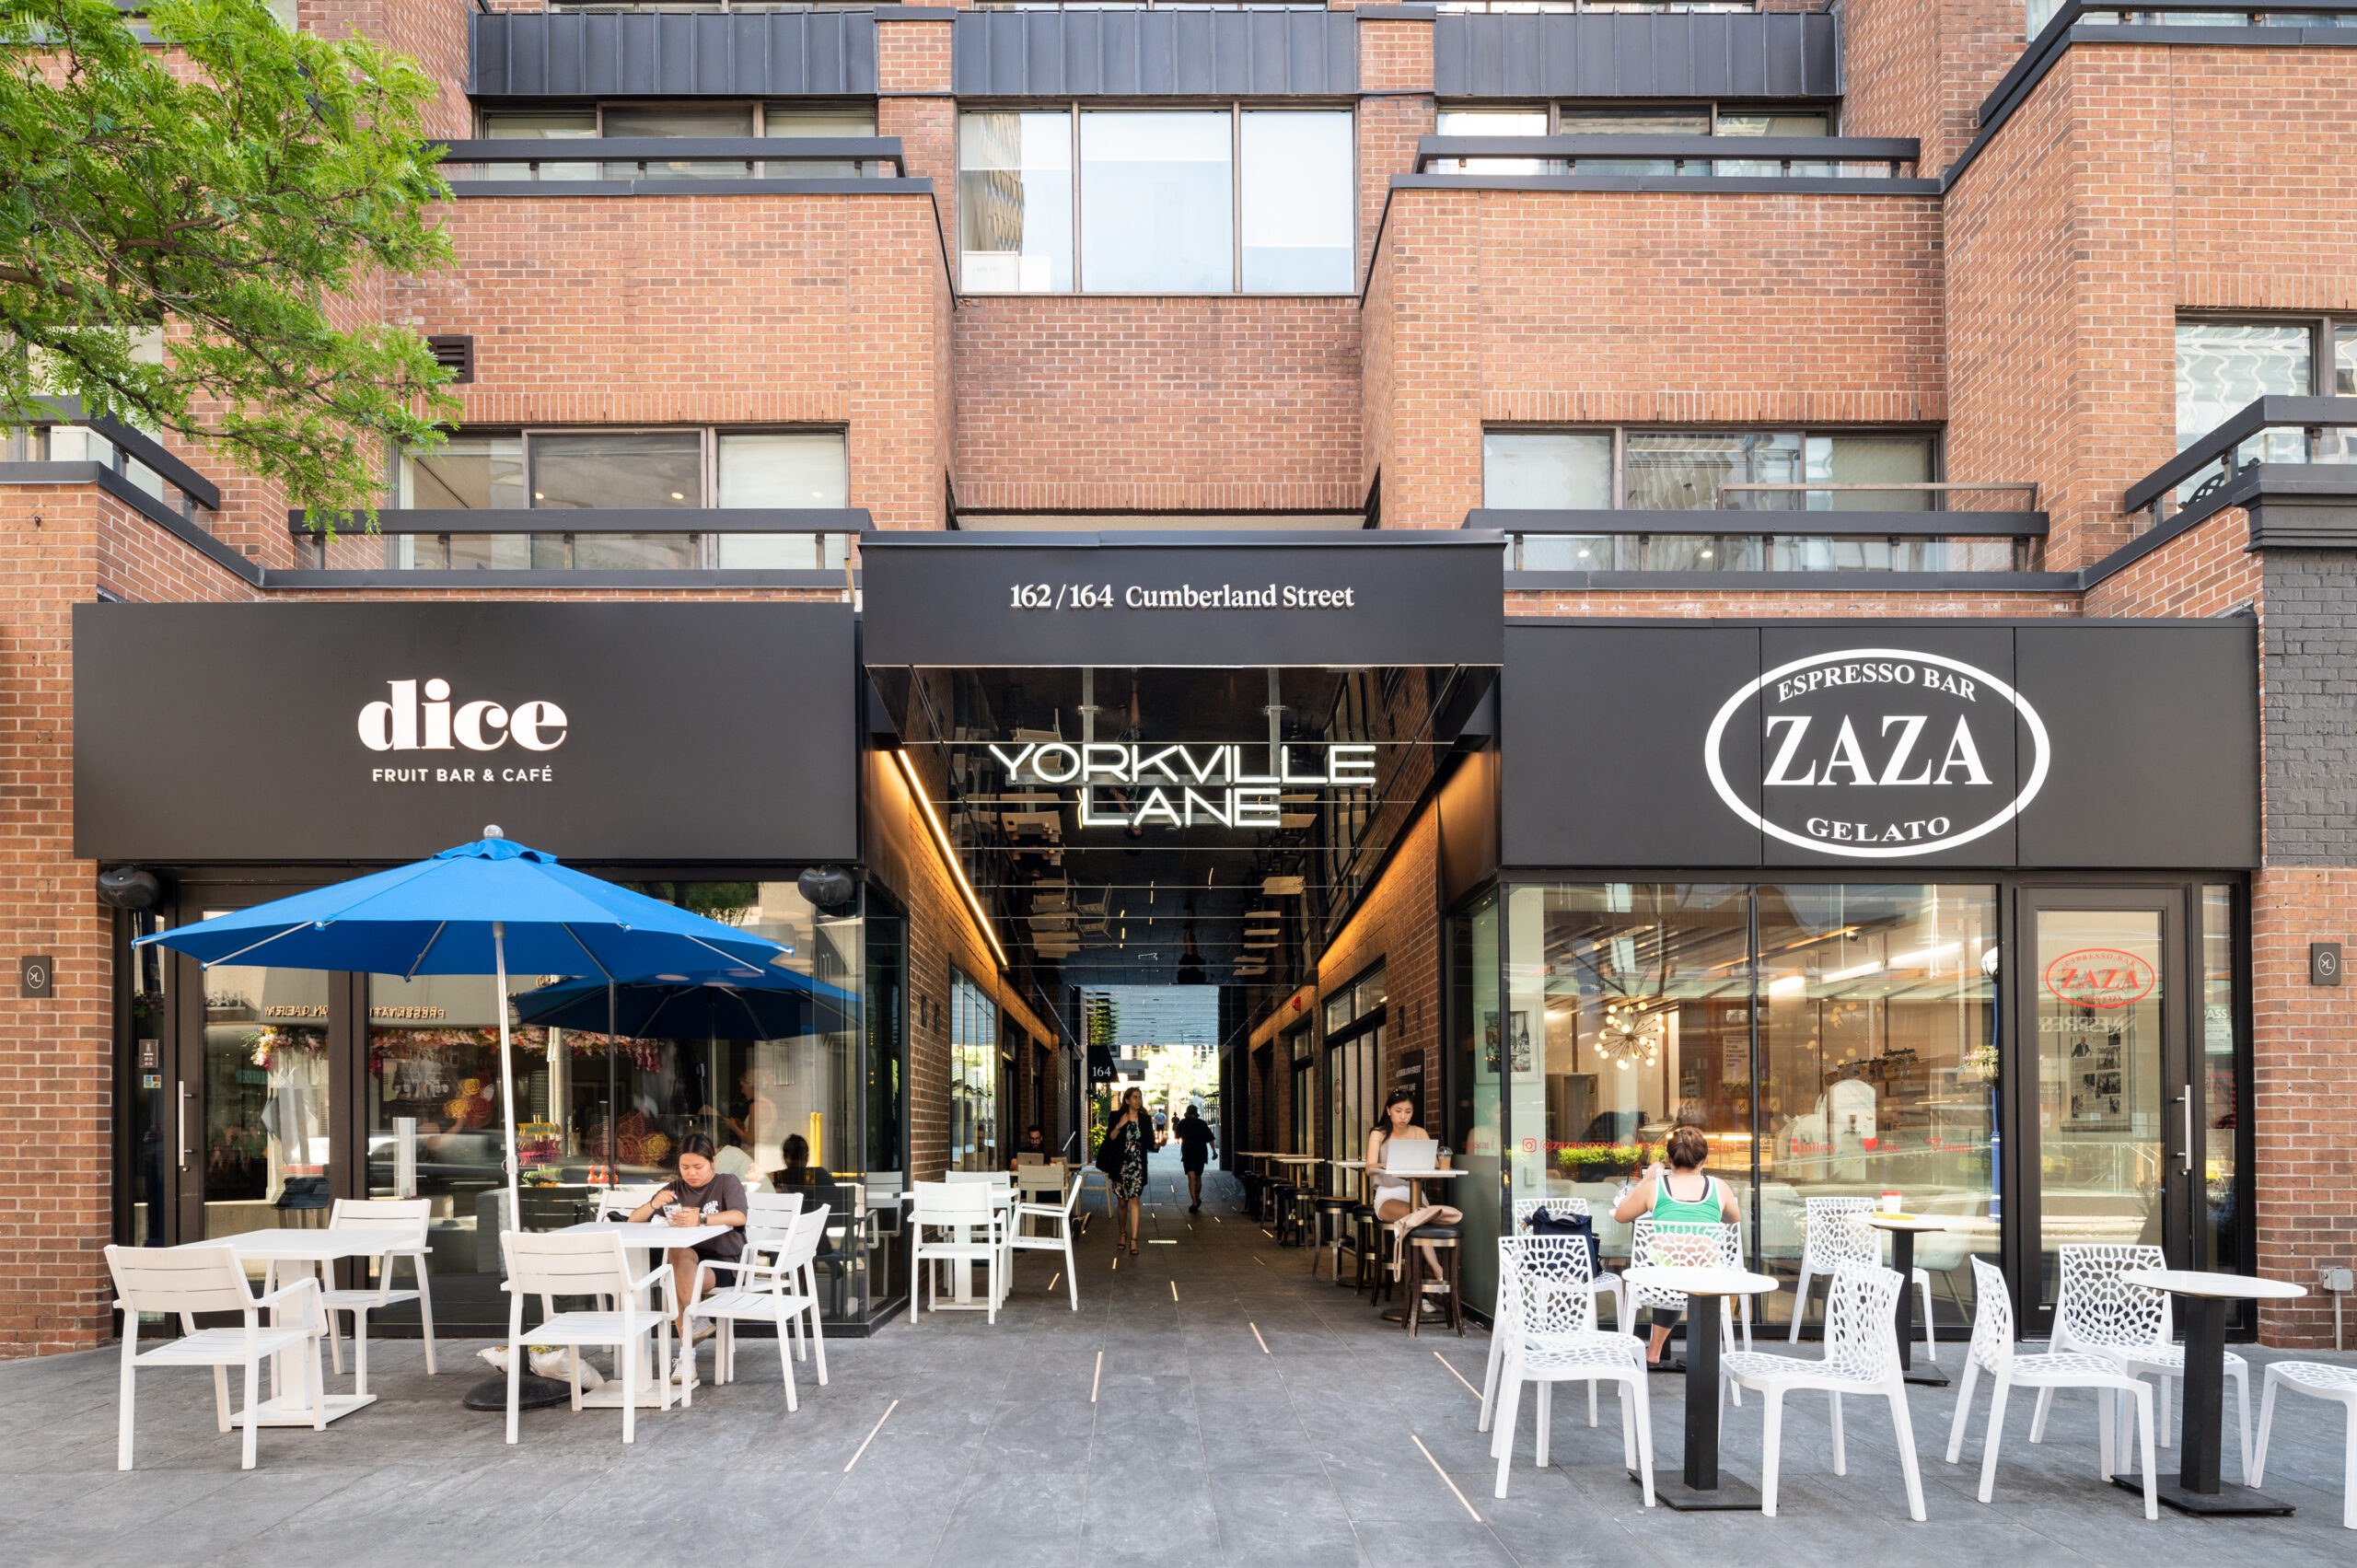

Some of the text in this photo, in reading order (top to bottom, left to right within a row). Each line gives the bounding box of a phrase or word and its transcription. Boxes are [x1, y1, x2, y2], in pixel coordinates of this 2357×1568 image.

[1126, 584, 1277, 608] Cumberland
[1283, 586, 1354, 607] Street
[1777, 662, 1976, 703] ESPRESSO BAR
[358, 679, 567, 750] dice
[1763, 714, 1992, 785] ZAZA
[373, 765, 552, 782] FRUIT BAR & CAFÉ
[990, 743, 1376, 784] YORKVILLE
[1081, 787, 1280, 828] LANE
[1806, 817, 1950, 842] GELATO
[2063, 953, 2137, 967] ESPRESSO BAR
[2061, 968, 2141, 990] ZAZA
[1092, 1066, 1111, 1077] 164
[1801, 1141, 1973, 1154] follow like share
